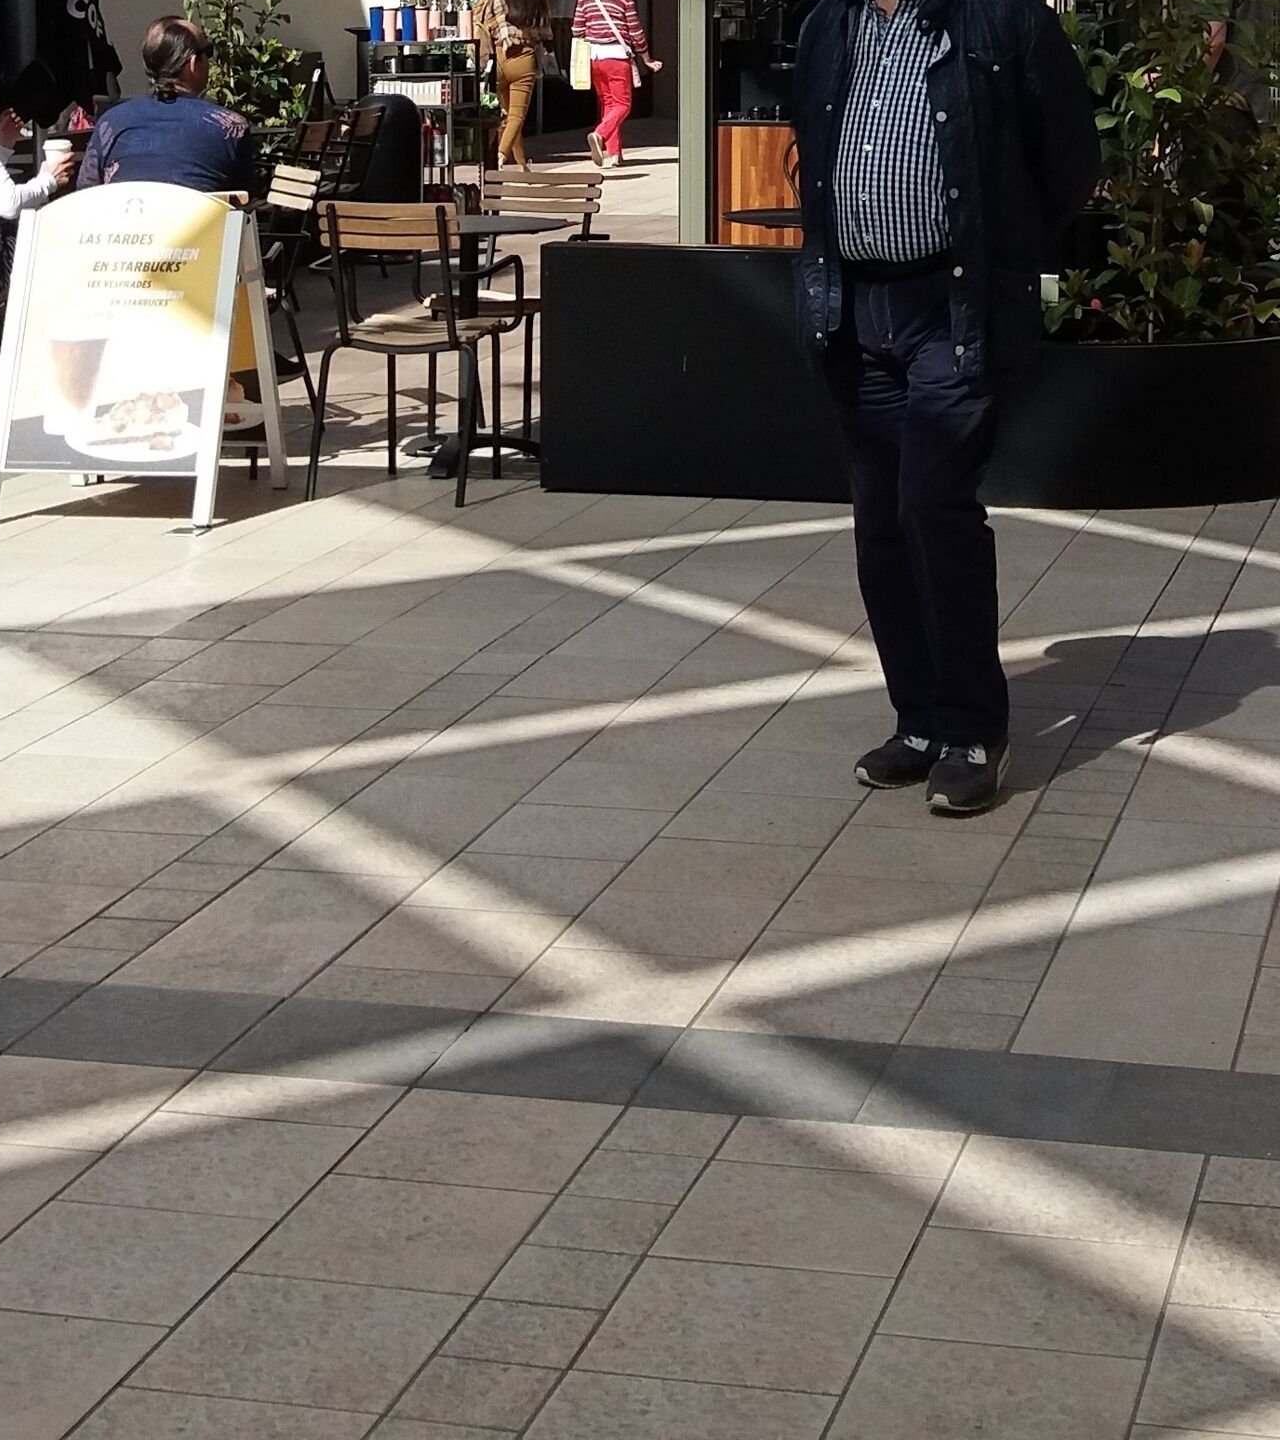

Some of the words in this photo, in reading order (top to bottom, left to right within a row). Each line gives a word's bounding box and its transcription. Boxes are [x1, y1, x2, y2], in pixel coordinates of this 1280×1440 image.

[78, 232, 103, 245] LAS
[105, 233, 156, 246] TARDES
[92, 261, 110, 273] EN
[87, 280, 105, 289] LES
